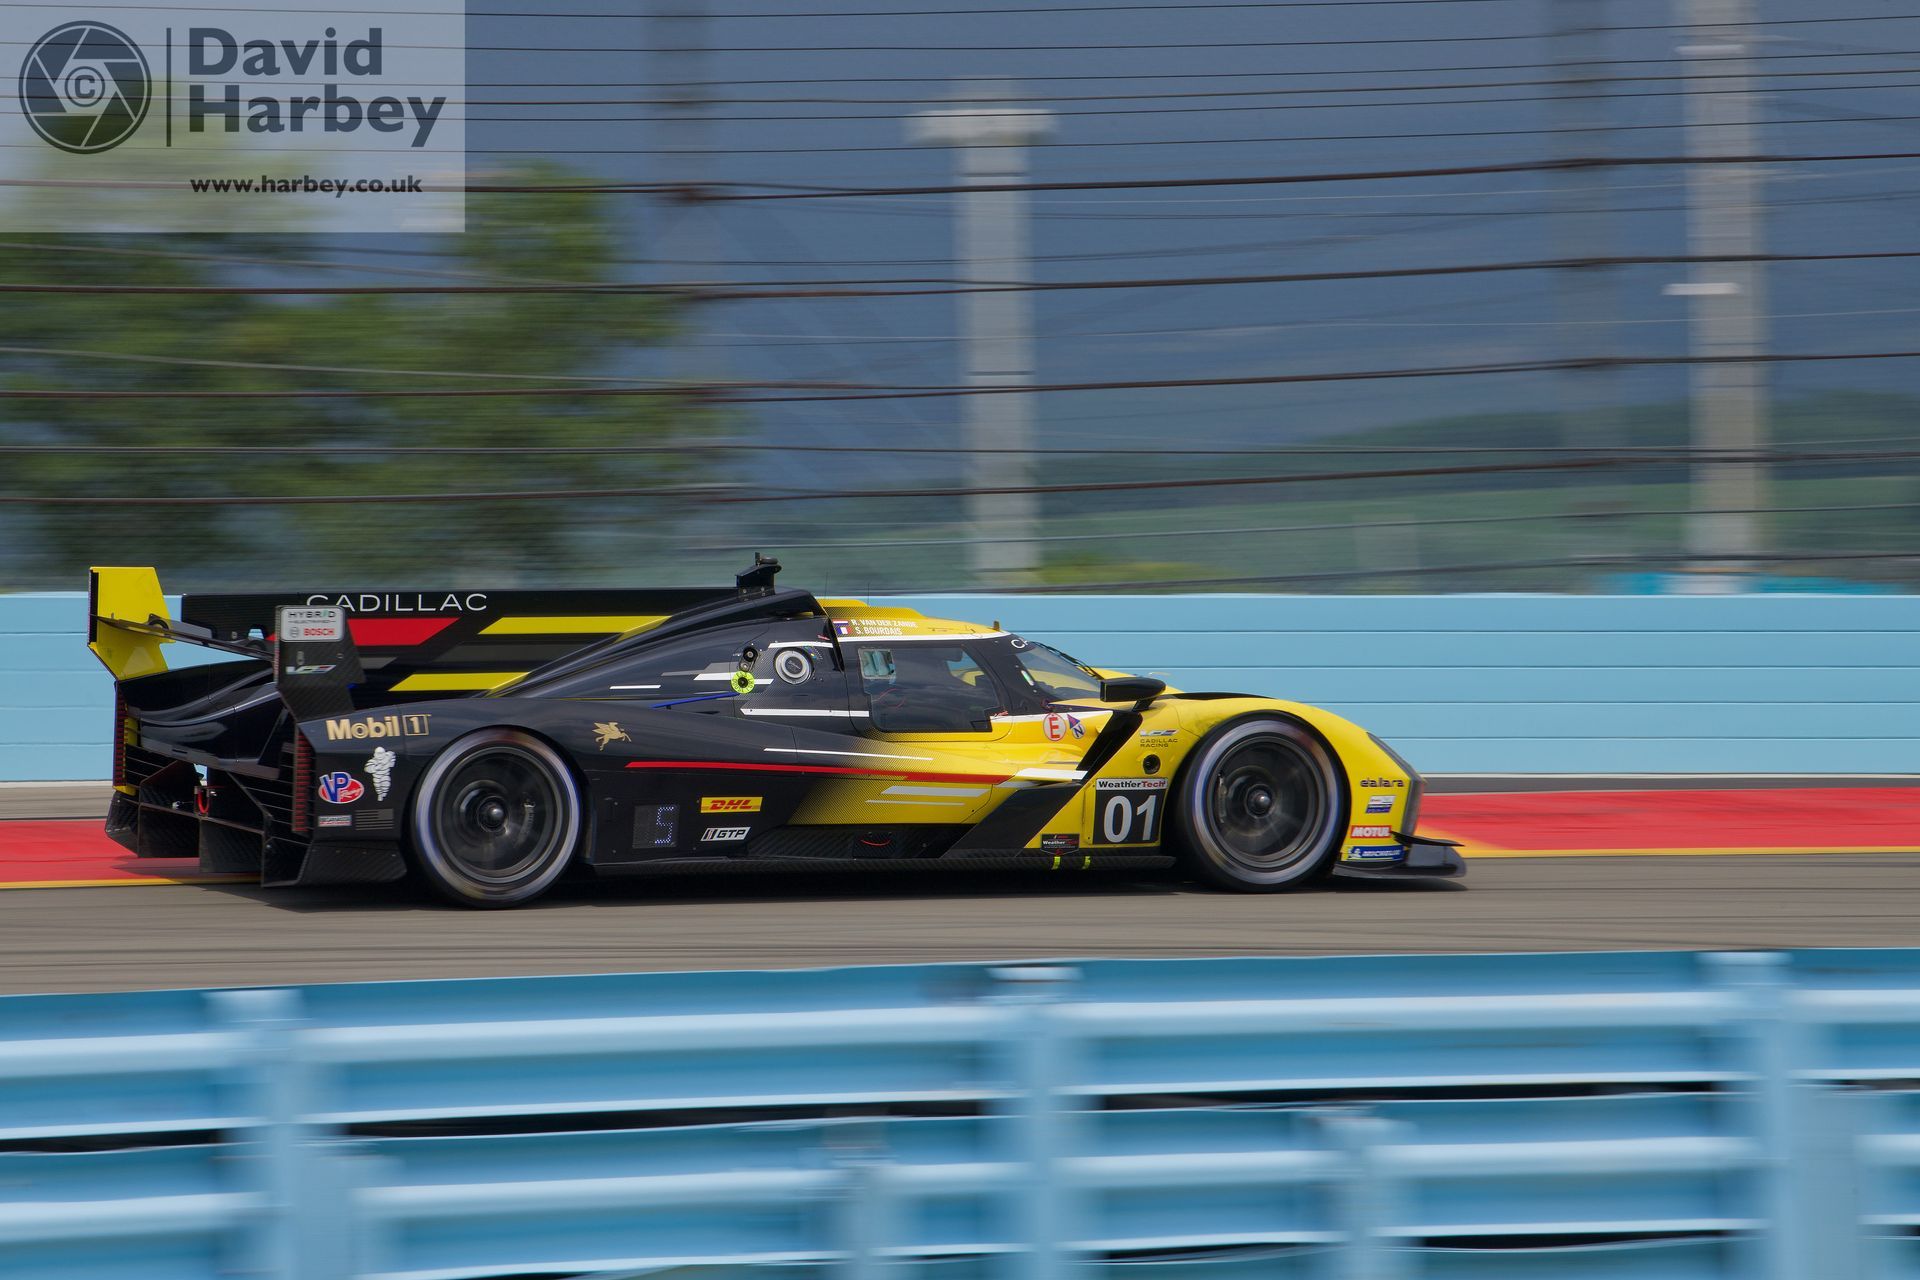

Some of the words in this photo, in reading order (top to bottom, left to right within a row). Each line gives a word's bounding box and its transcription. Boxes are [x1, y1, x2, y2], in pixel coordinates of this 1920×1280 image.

[306, 594, 487, 612] CADILLAC
[288, 610, 336, 618] HYBRID
[877, 619, 891, 627] DER
[304, 628, 336, 636] BOSCH
[855, 627, 864, 635] S.
[864, 627, 903, 635] BOURDAIS
[325, 715, 400, 741] Mobil
[1049, 716, 1060, 739] E
[1073, 725, 1084, 738] N
[319, 772, 351, 803] VP
[1098, 780, 1166, 788] WeatherTech
[1360, 777, 1404, 788] dallara
[710, 799, 753, 811] DHL
[1103, 794, 1157, 843] 01
[716, 829, 747, 839] GTP
[1351, 826, 1391, 837] MOTUL
